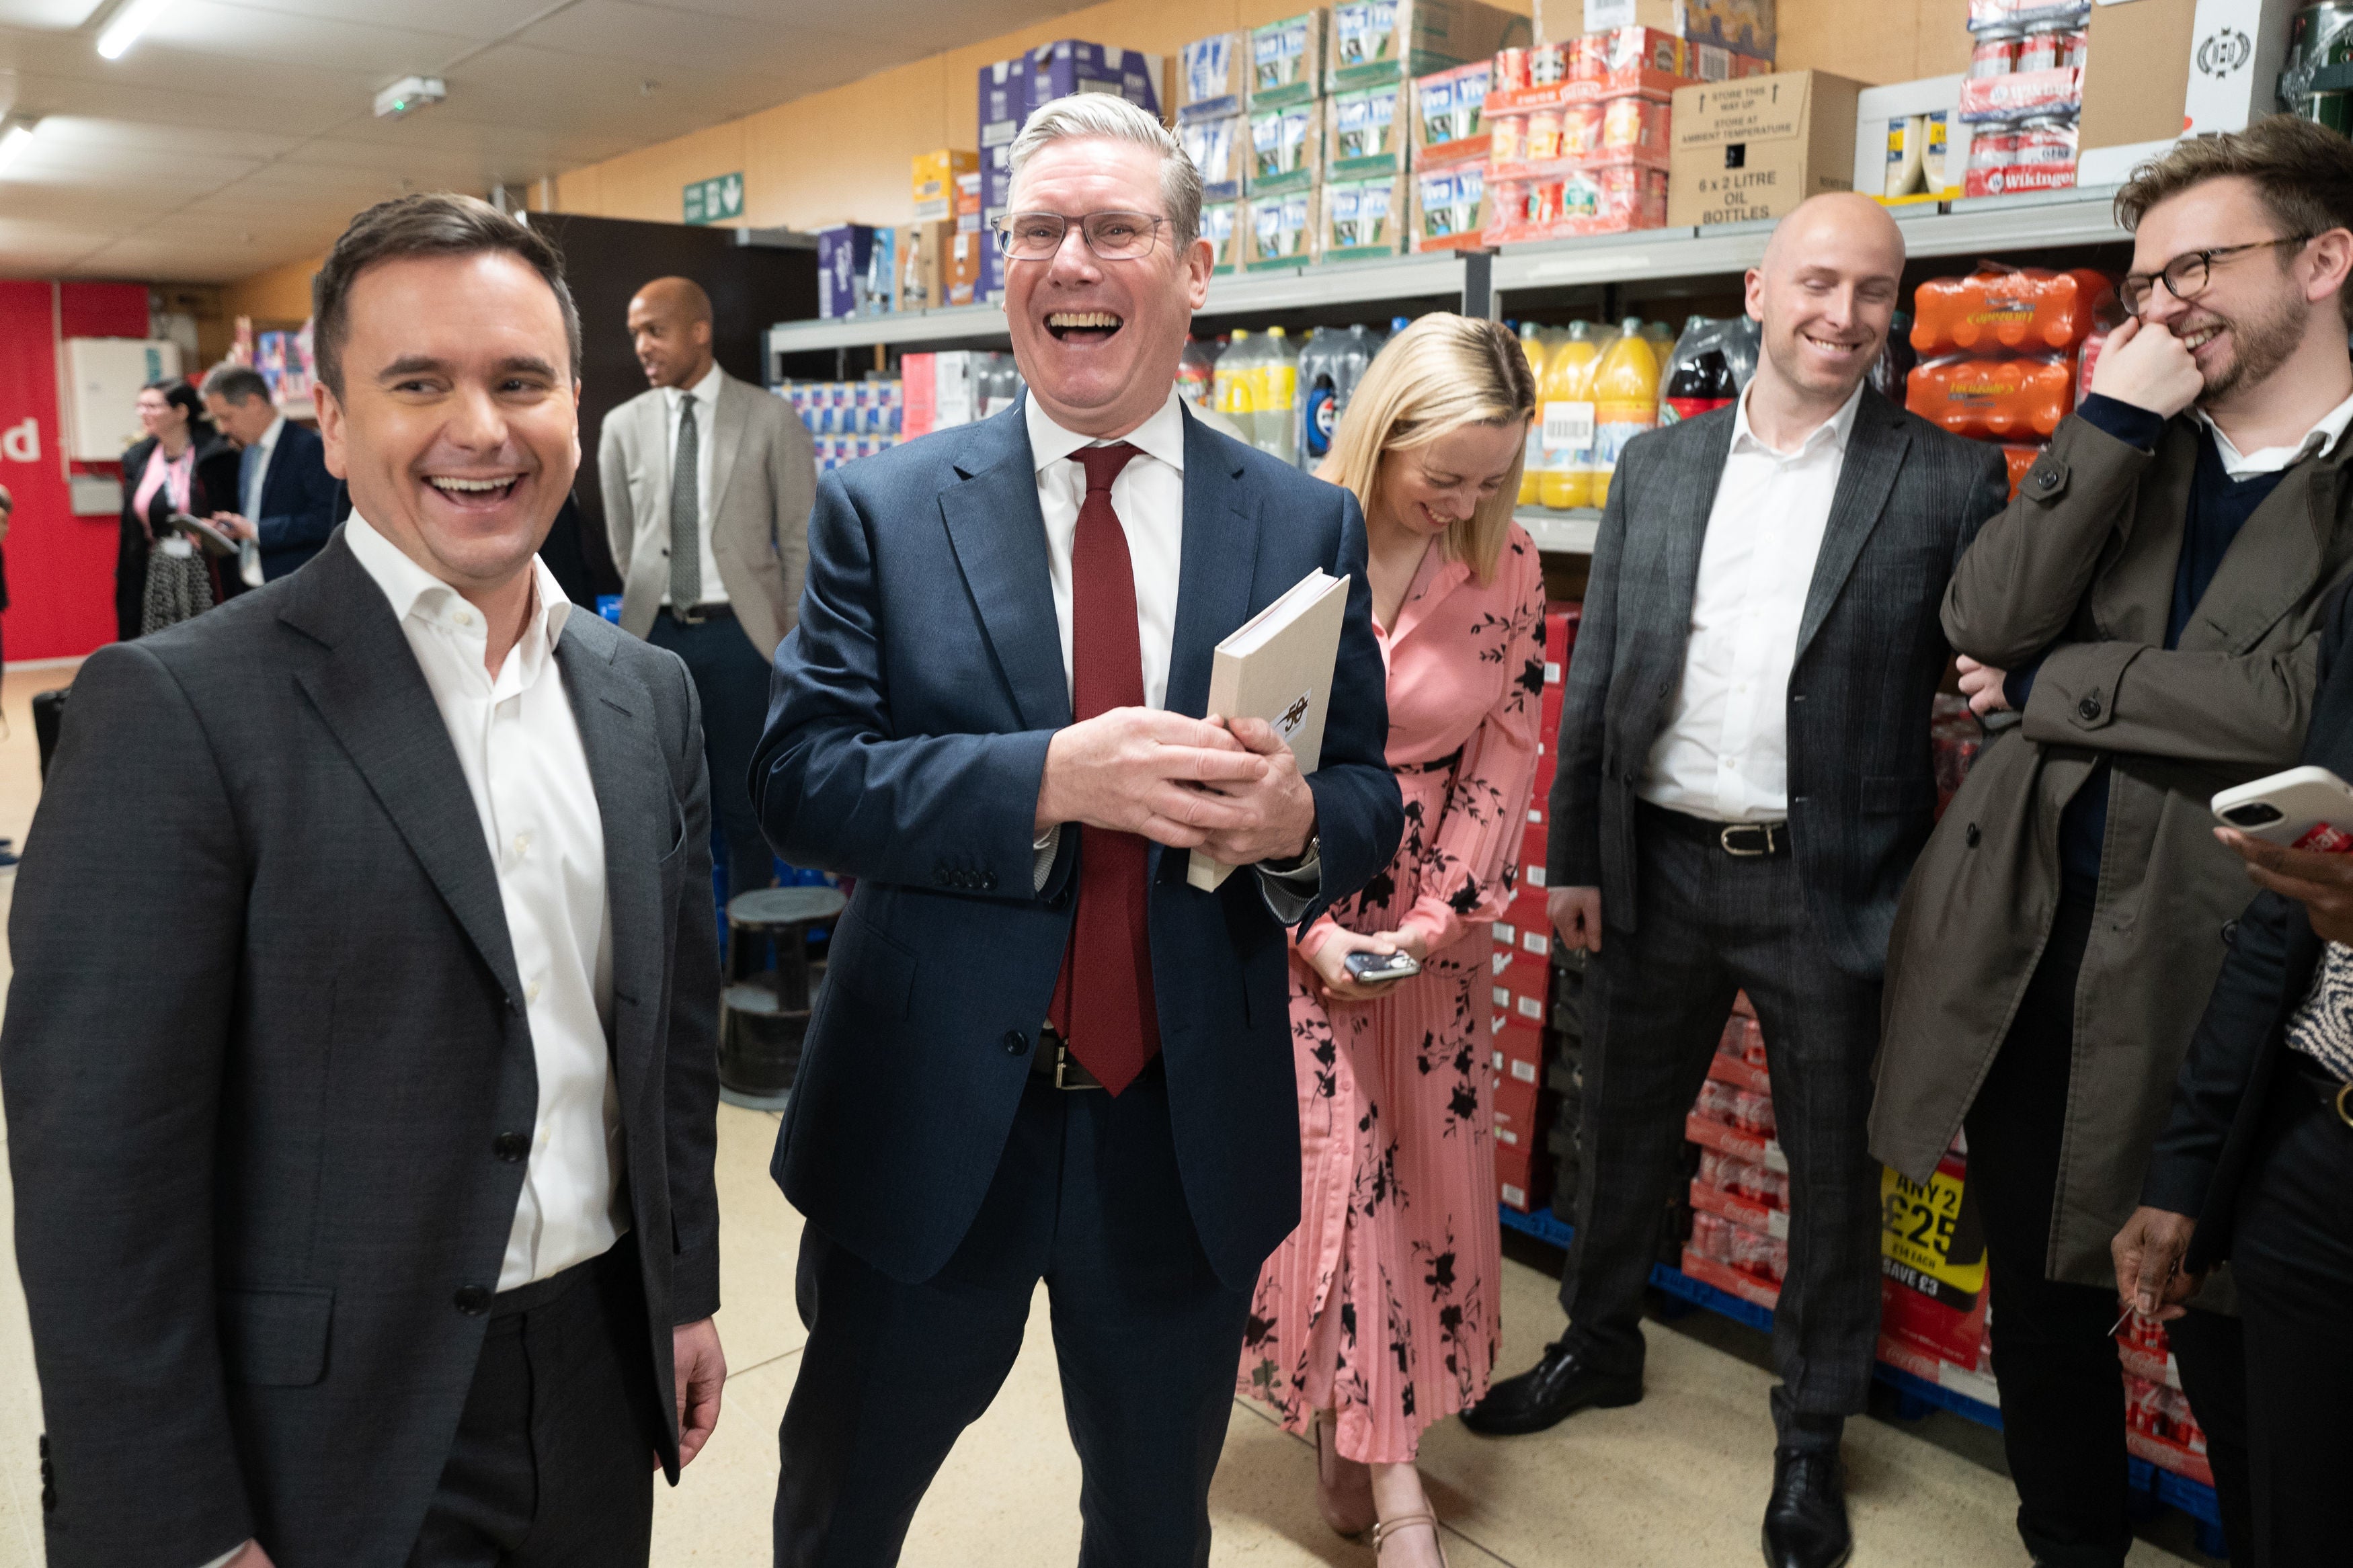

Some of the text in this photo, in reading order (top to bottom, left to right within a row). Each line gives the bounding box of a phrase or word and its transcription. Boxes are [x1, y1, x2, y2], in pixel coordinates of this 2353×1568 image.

[1712, 90, 1741, 101] STORE
[1720, 100, 1754, 111] WAY UP
[1715, 116, 1757, 127] STORE AT
[1682, 123, 1791, 143] AMBIENT TEMPERATURE
[1699, 179, 1707, 192] 6
[1722, 177, 1730, 190] 2
[1734, 171, 1776, 188] LITRE
[1724, 192, 1747, 206] OIL
[1703, 206, 1769, 224] BOTTLES
[1896, 1173, 1956, 1213] ANY 2
[1882, 1194, 1957, 1256] £25
[1911, 1251, 1936, 1269] EACH
[1882, 1257, 1917, 1286] SAVE
